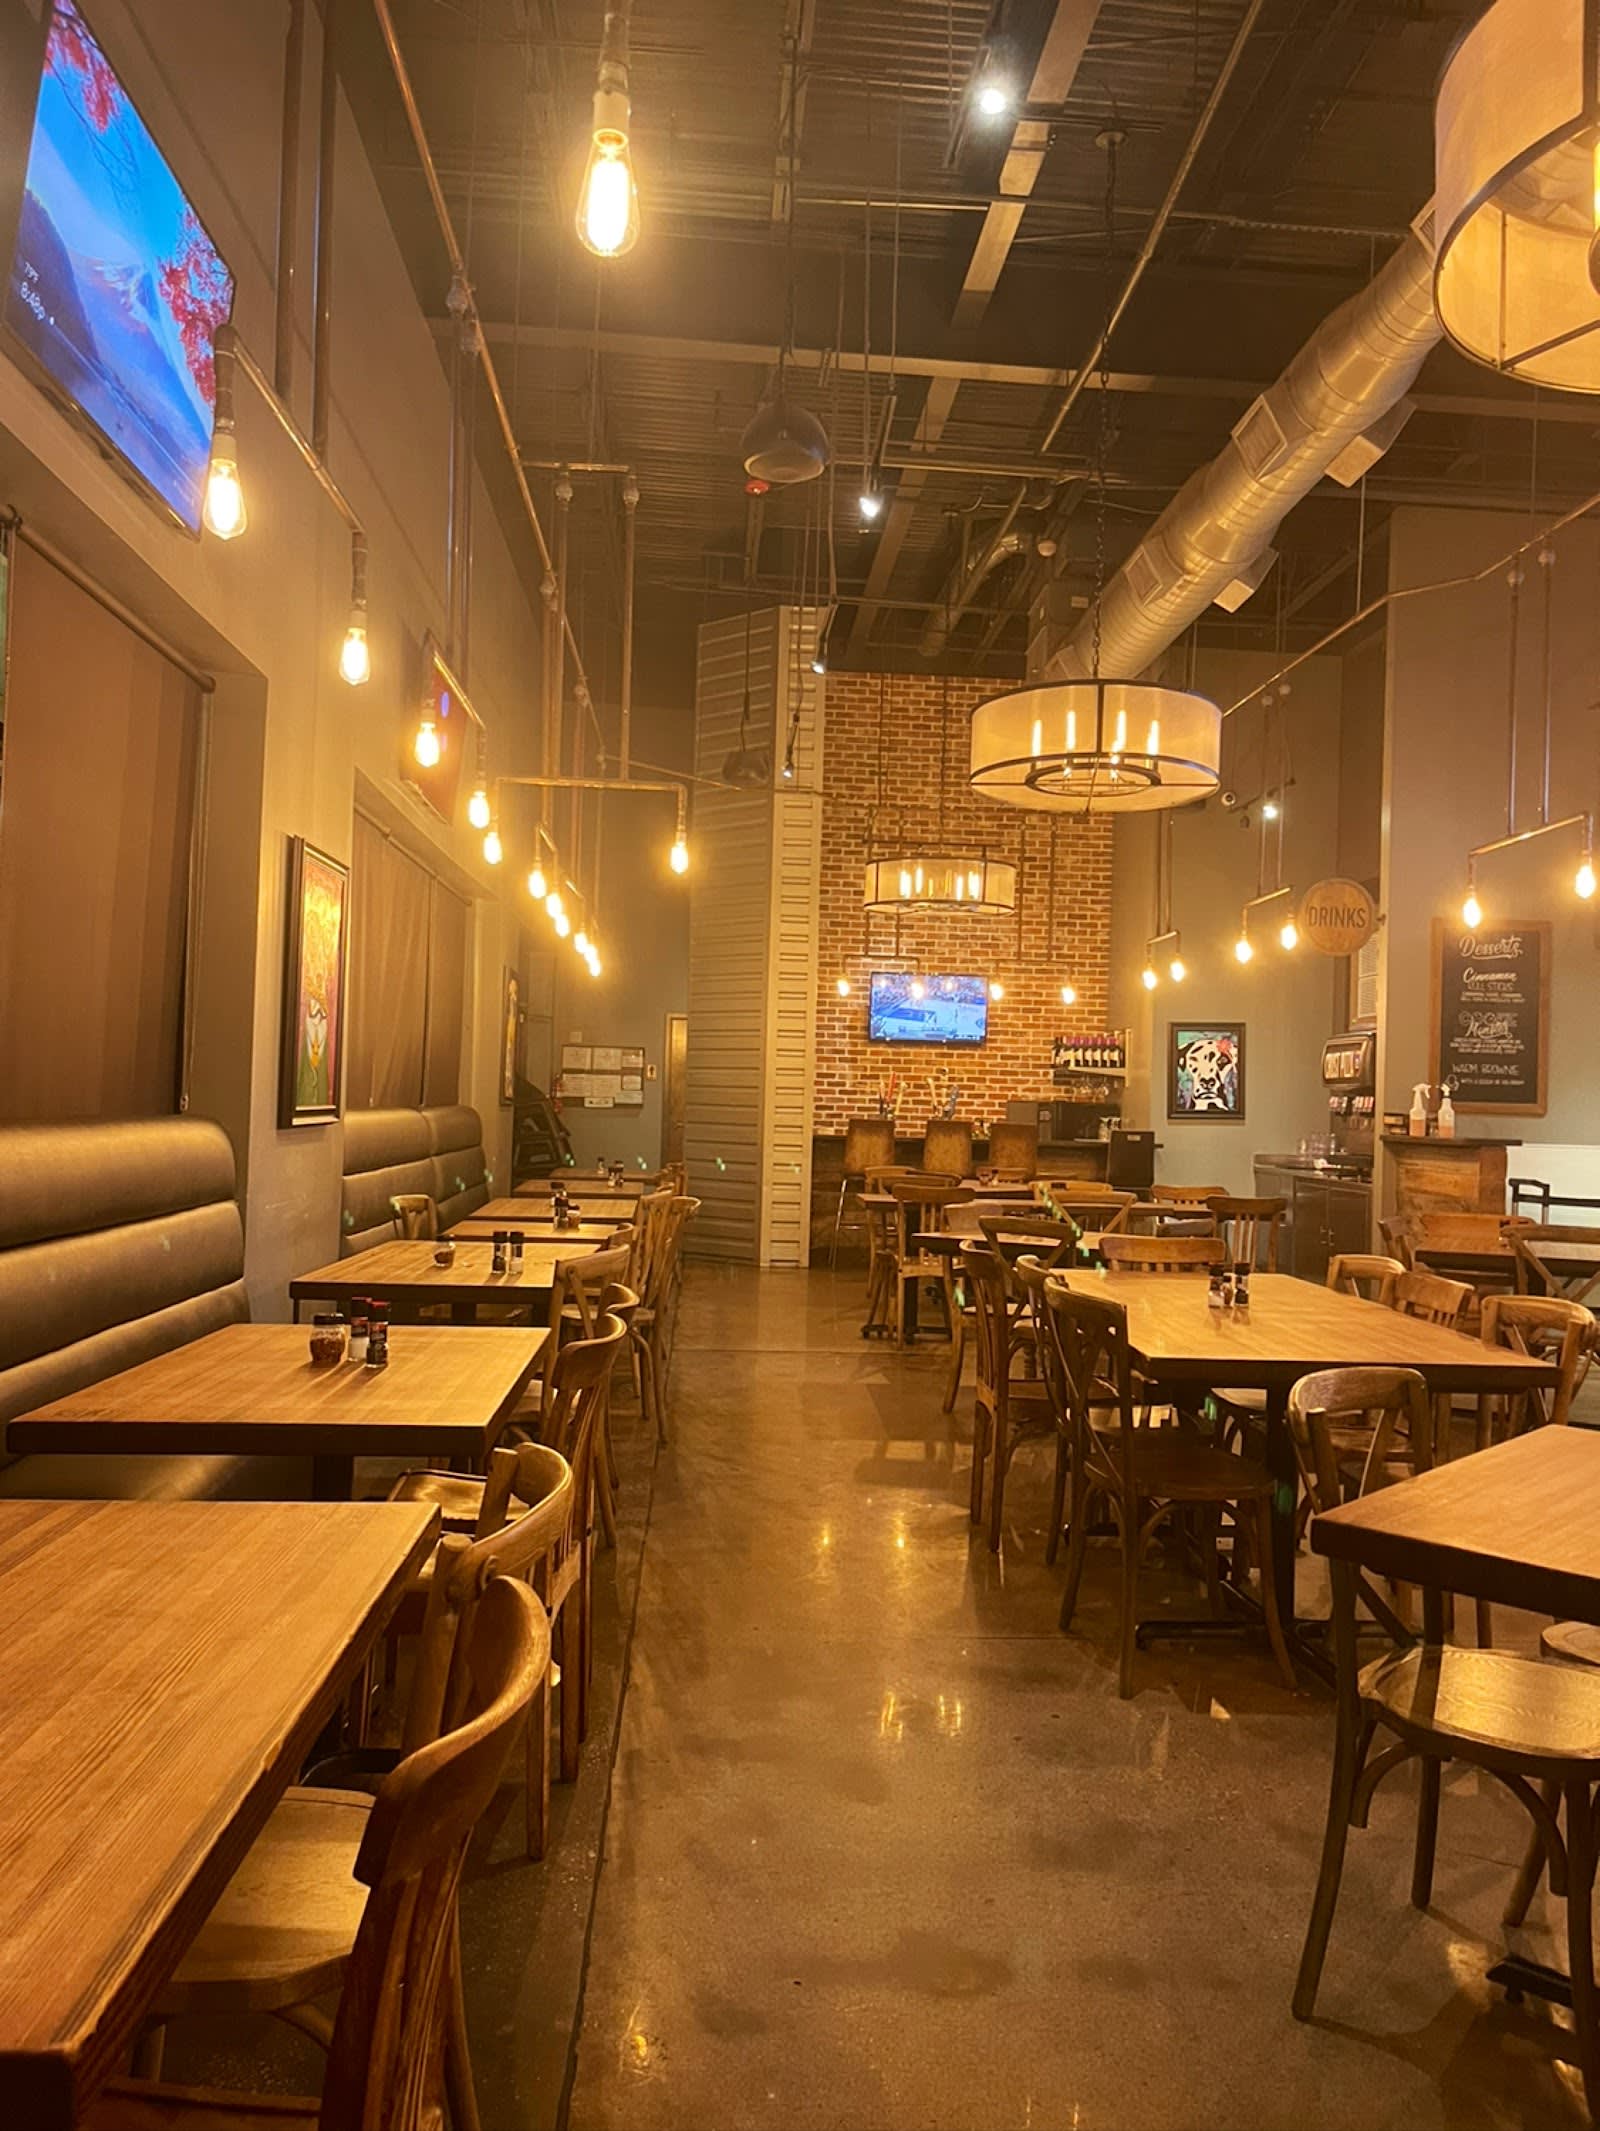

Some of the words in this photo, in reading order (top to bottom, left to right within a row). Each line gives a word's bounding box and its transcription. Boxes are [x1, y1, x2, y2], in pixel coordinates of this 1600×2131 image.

[1308, 905, 1366, 929] DRINKS
[1459, 934, 1523, 960] Desserts
[1463, 967, 1517, 983] Cinnamon
